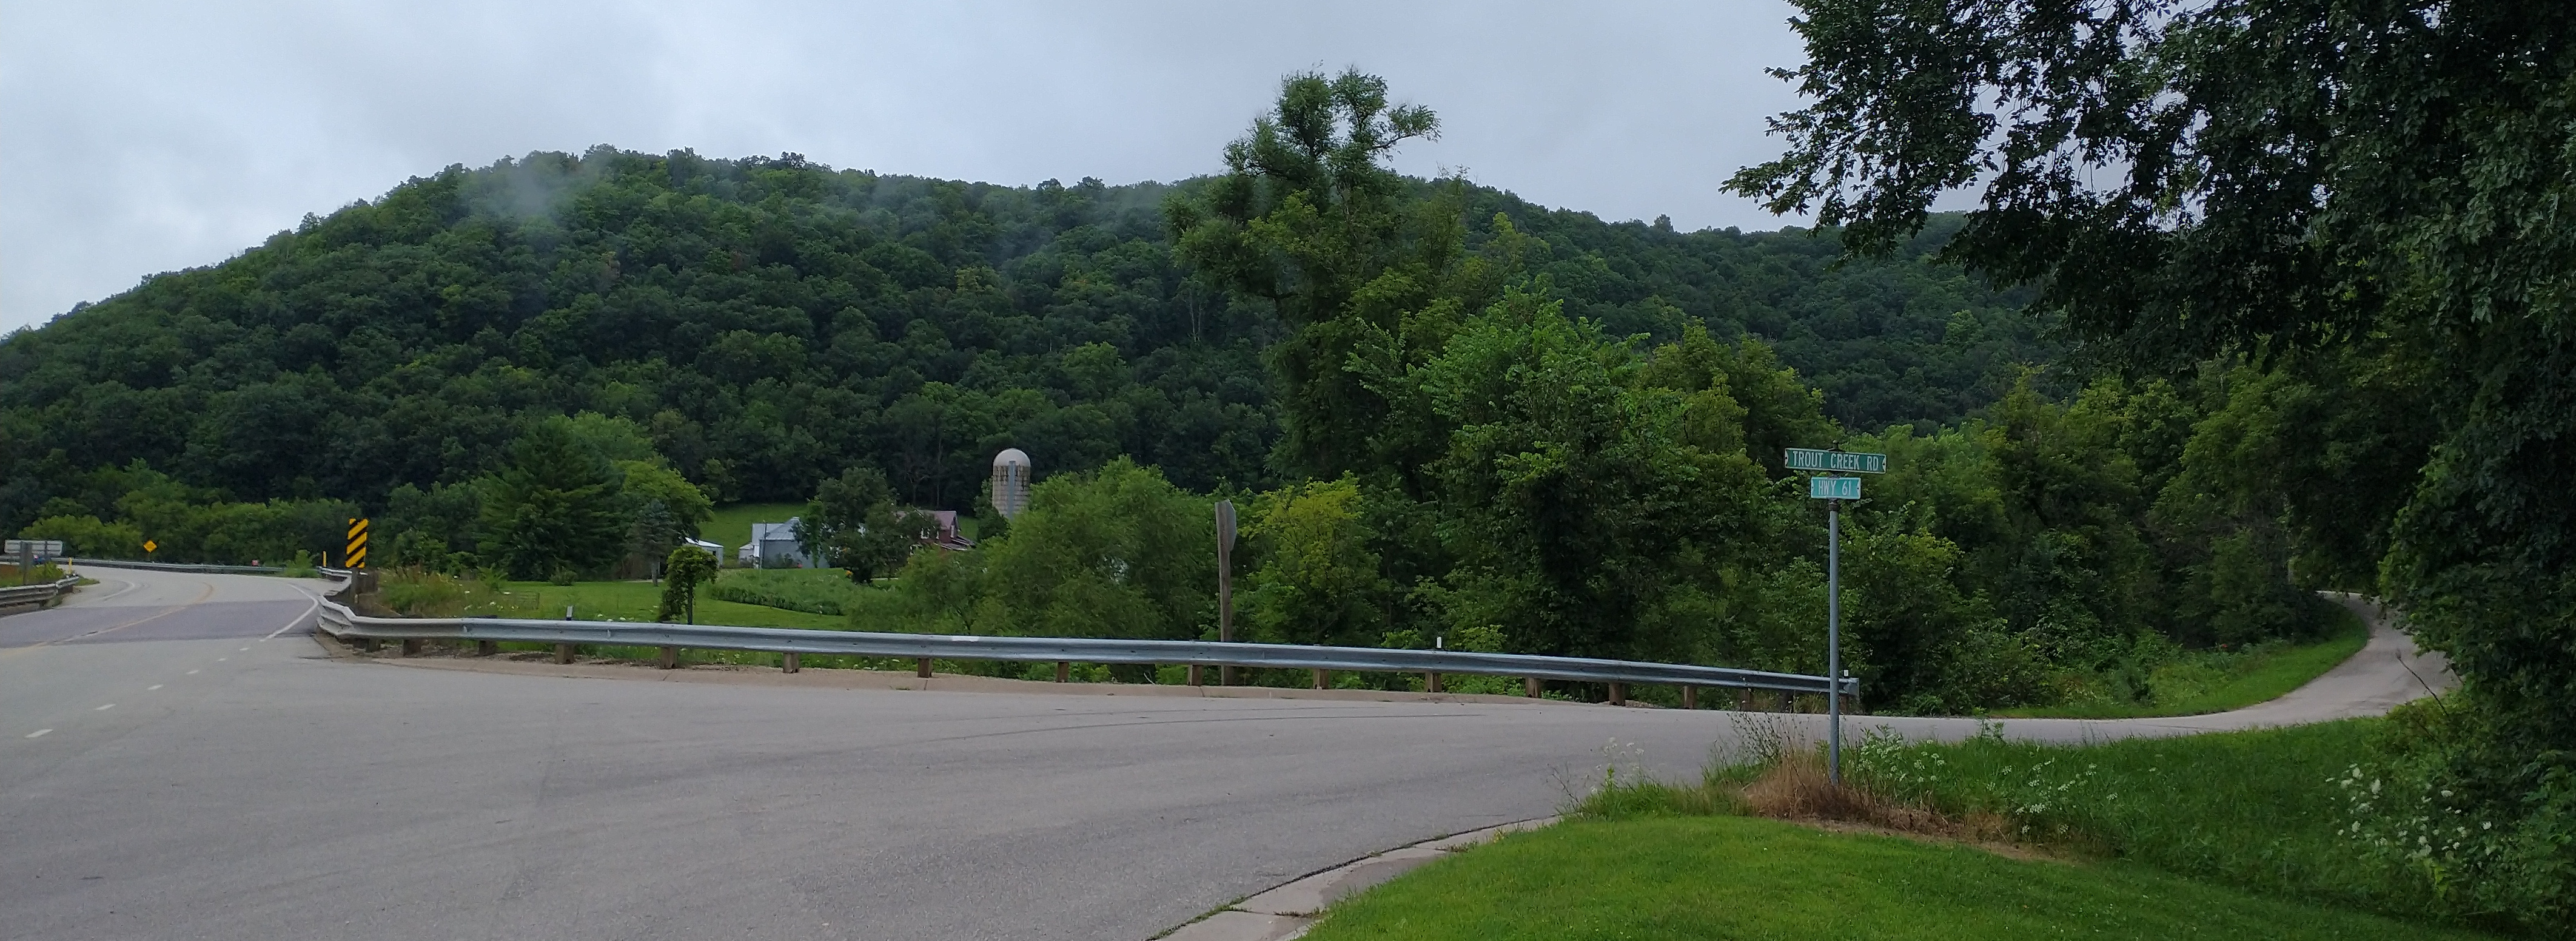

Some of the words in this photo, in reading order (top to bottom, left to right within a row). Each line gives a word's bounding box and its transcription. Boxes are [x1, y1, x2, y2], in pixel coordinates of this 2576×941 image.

[1793, 451, 1823, 468] TROUT
[1830, 453, 1860, 470] CREEK
[1867, 456, 1879, 471] RD
[1818, 480, 1837, 496] HWY
[1842, 481, 1851, 496] 61
